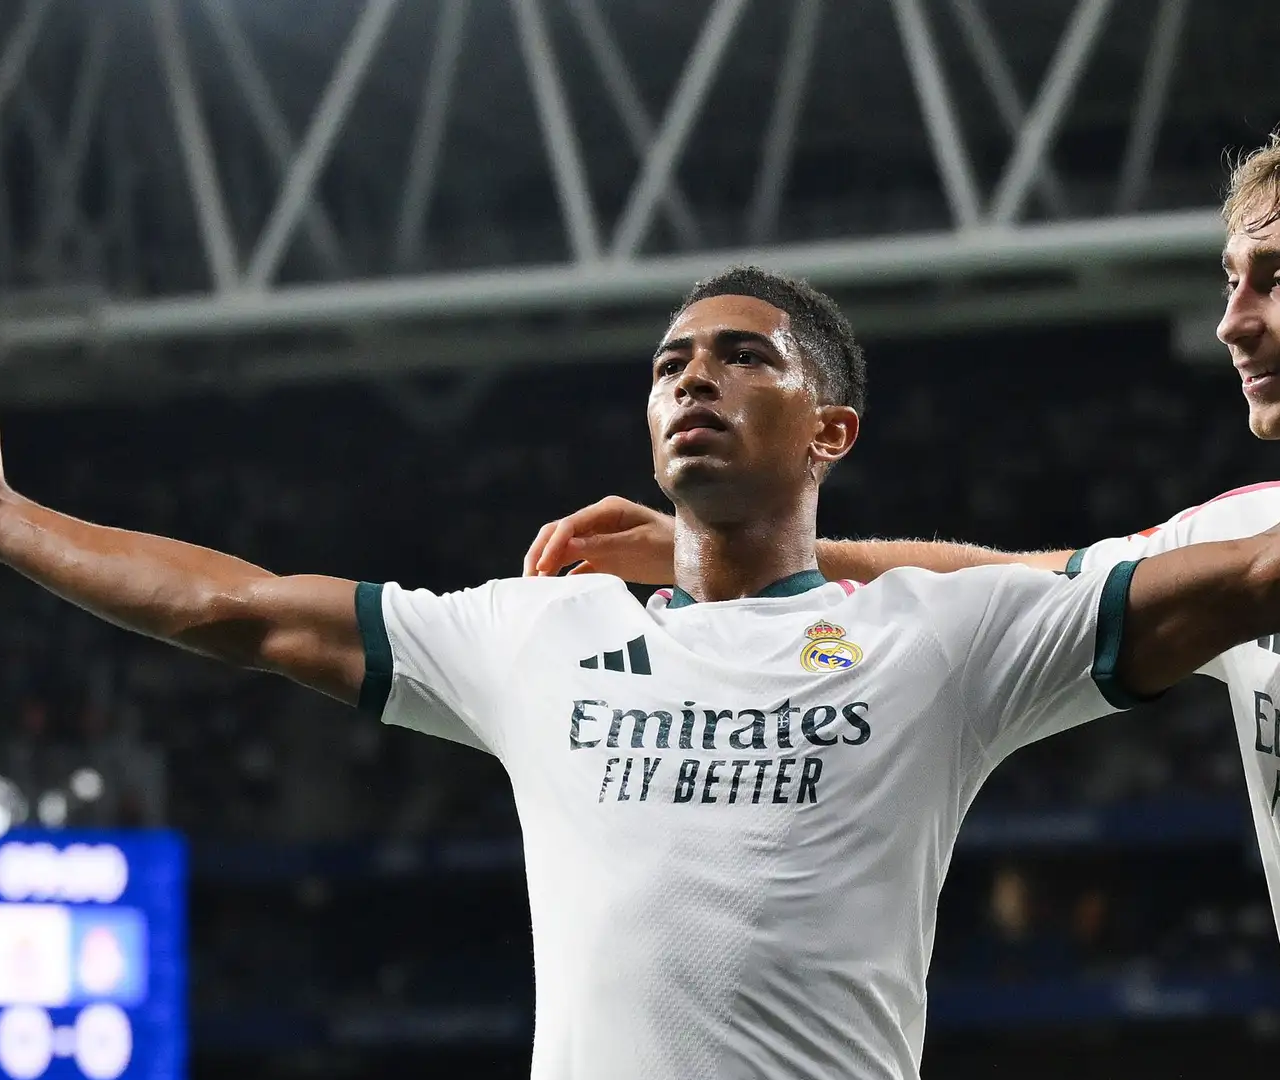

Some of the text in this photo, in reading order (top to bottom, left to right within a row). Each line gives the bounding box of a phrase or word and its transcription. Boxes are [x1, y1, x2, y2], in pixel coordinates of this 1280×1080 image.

[570, 698, 872, 751] Emirates
[597, 757, 824, 805] FLY BETTER
